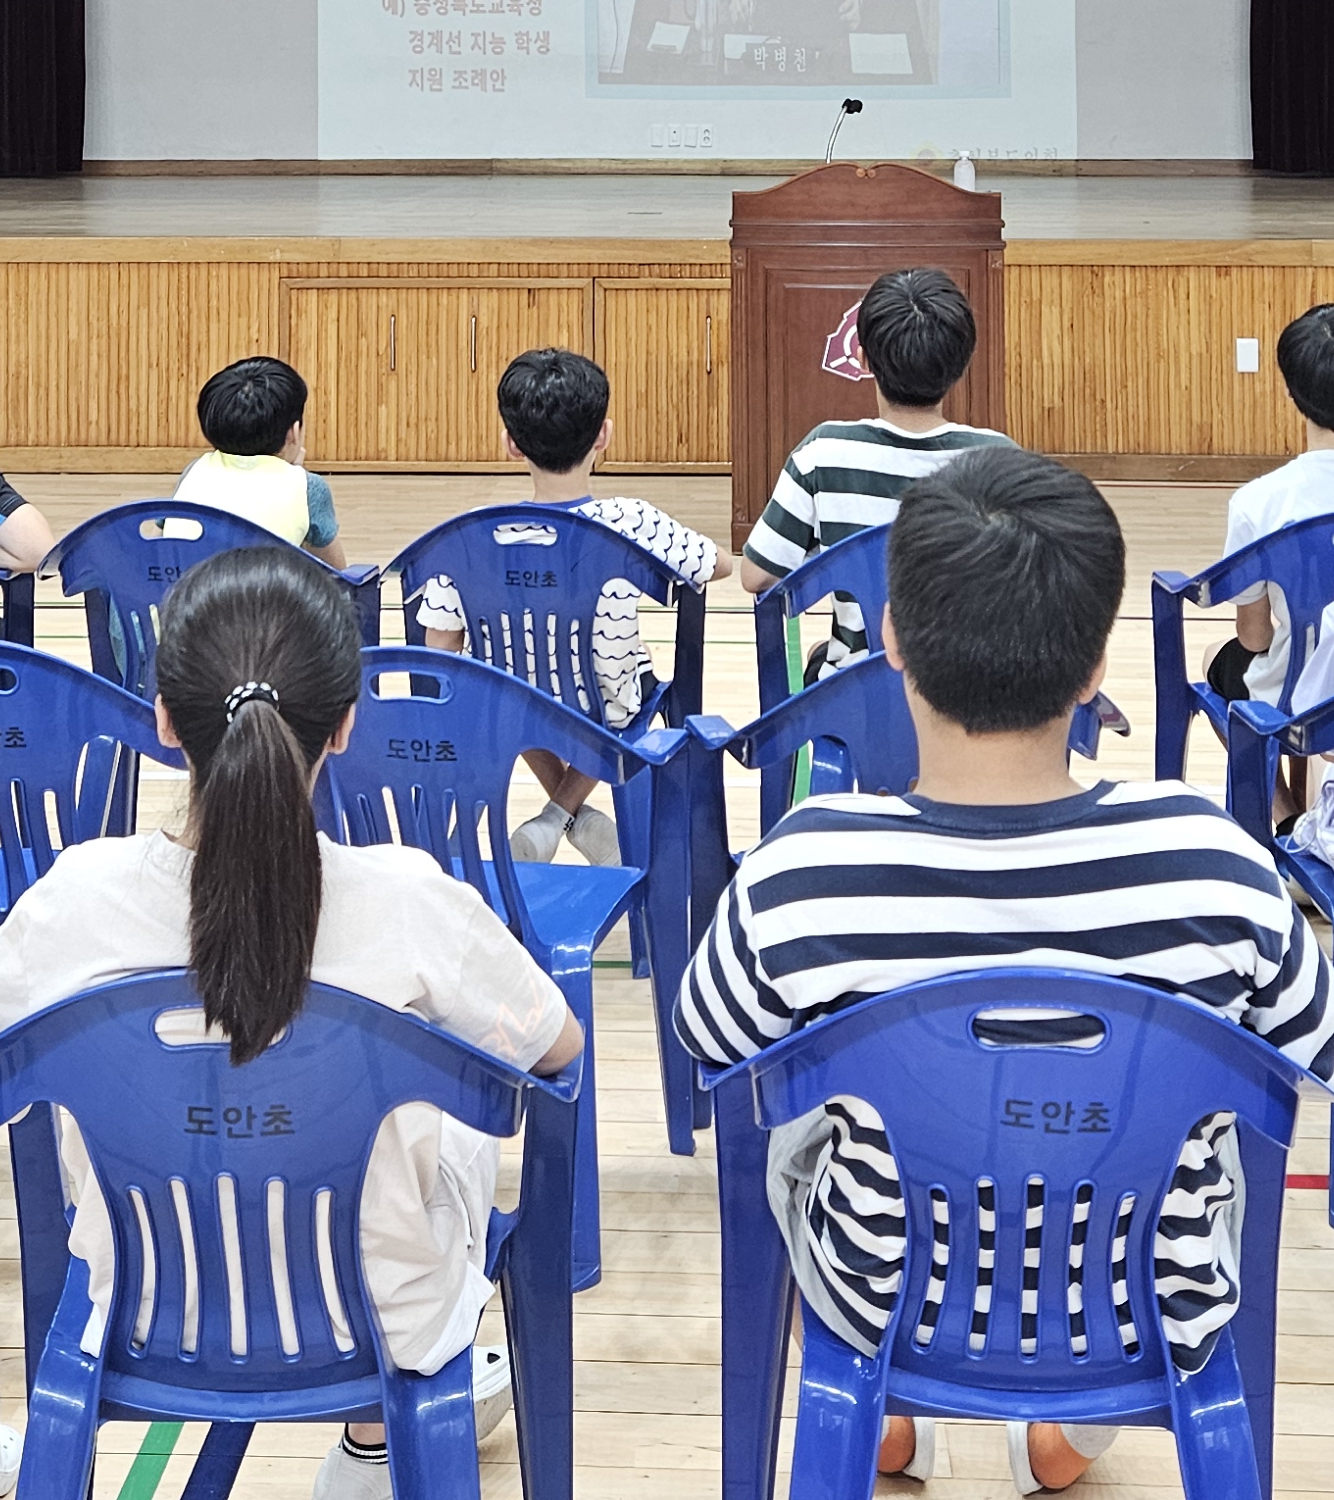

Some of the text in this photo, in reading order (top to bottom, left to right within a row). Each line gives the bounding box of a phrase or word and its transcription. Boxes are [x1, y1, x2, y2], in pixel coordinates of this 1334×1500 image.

[409, 30, 550, 55] 경계선 지능 학생
[409, 68, 506, 92] 지원 조례안
[147, 565, 182, 583] 도안
[505, 570, 557, 588] 도안초
[387, 739, 457, 762] 도안초
[184, 1105, 295, 1139] 도안초
[1000, 1099, 1111, 1135] 도안초
